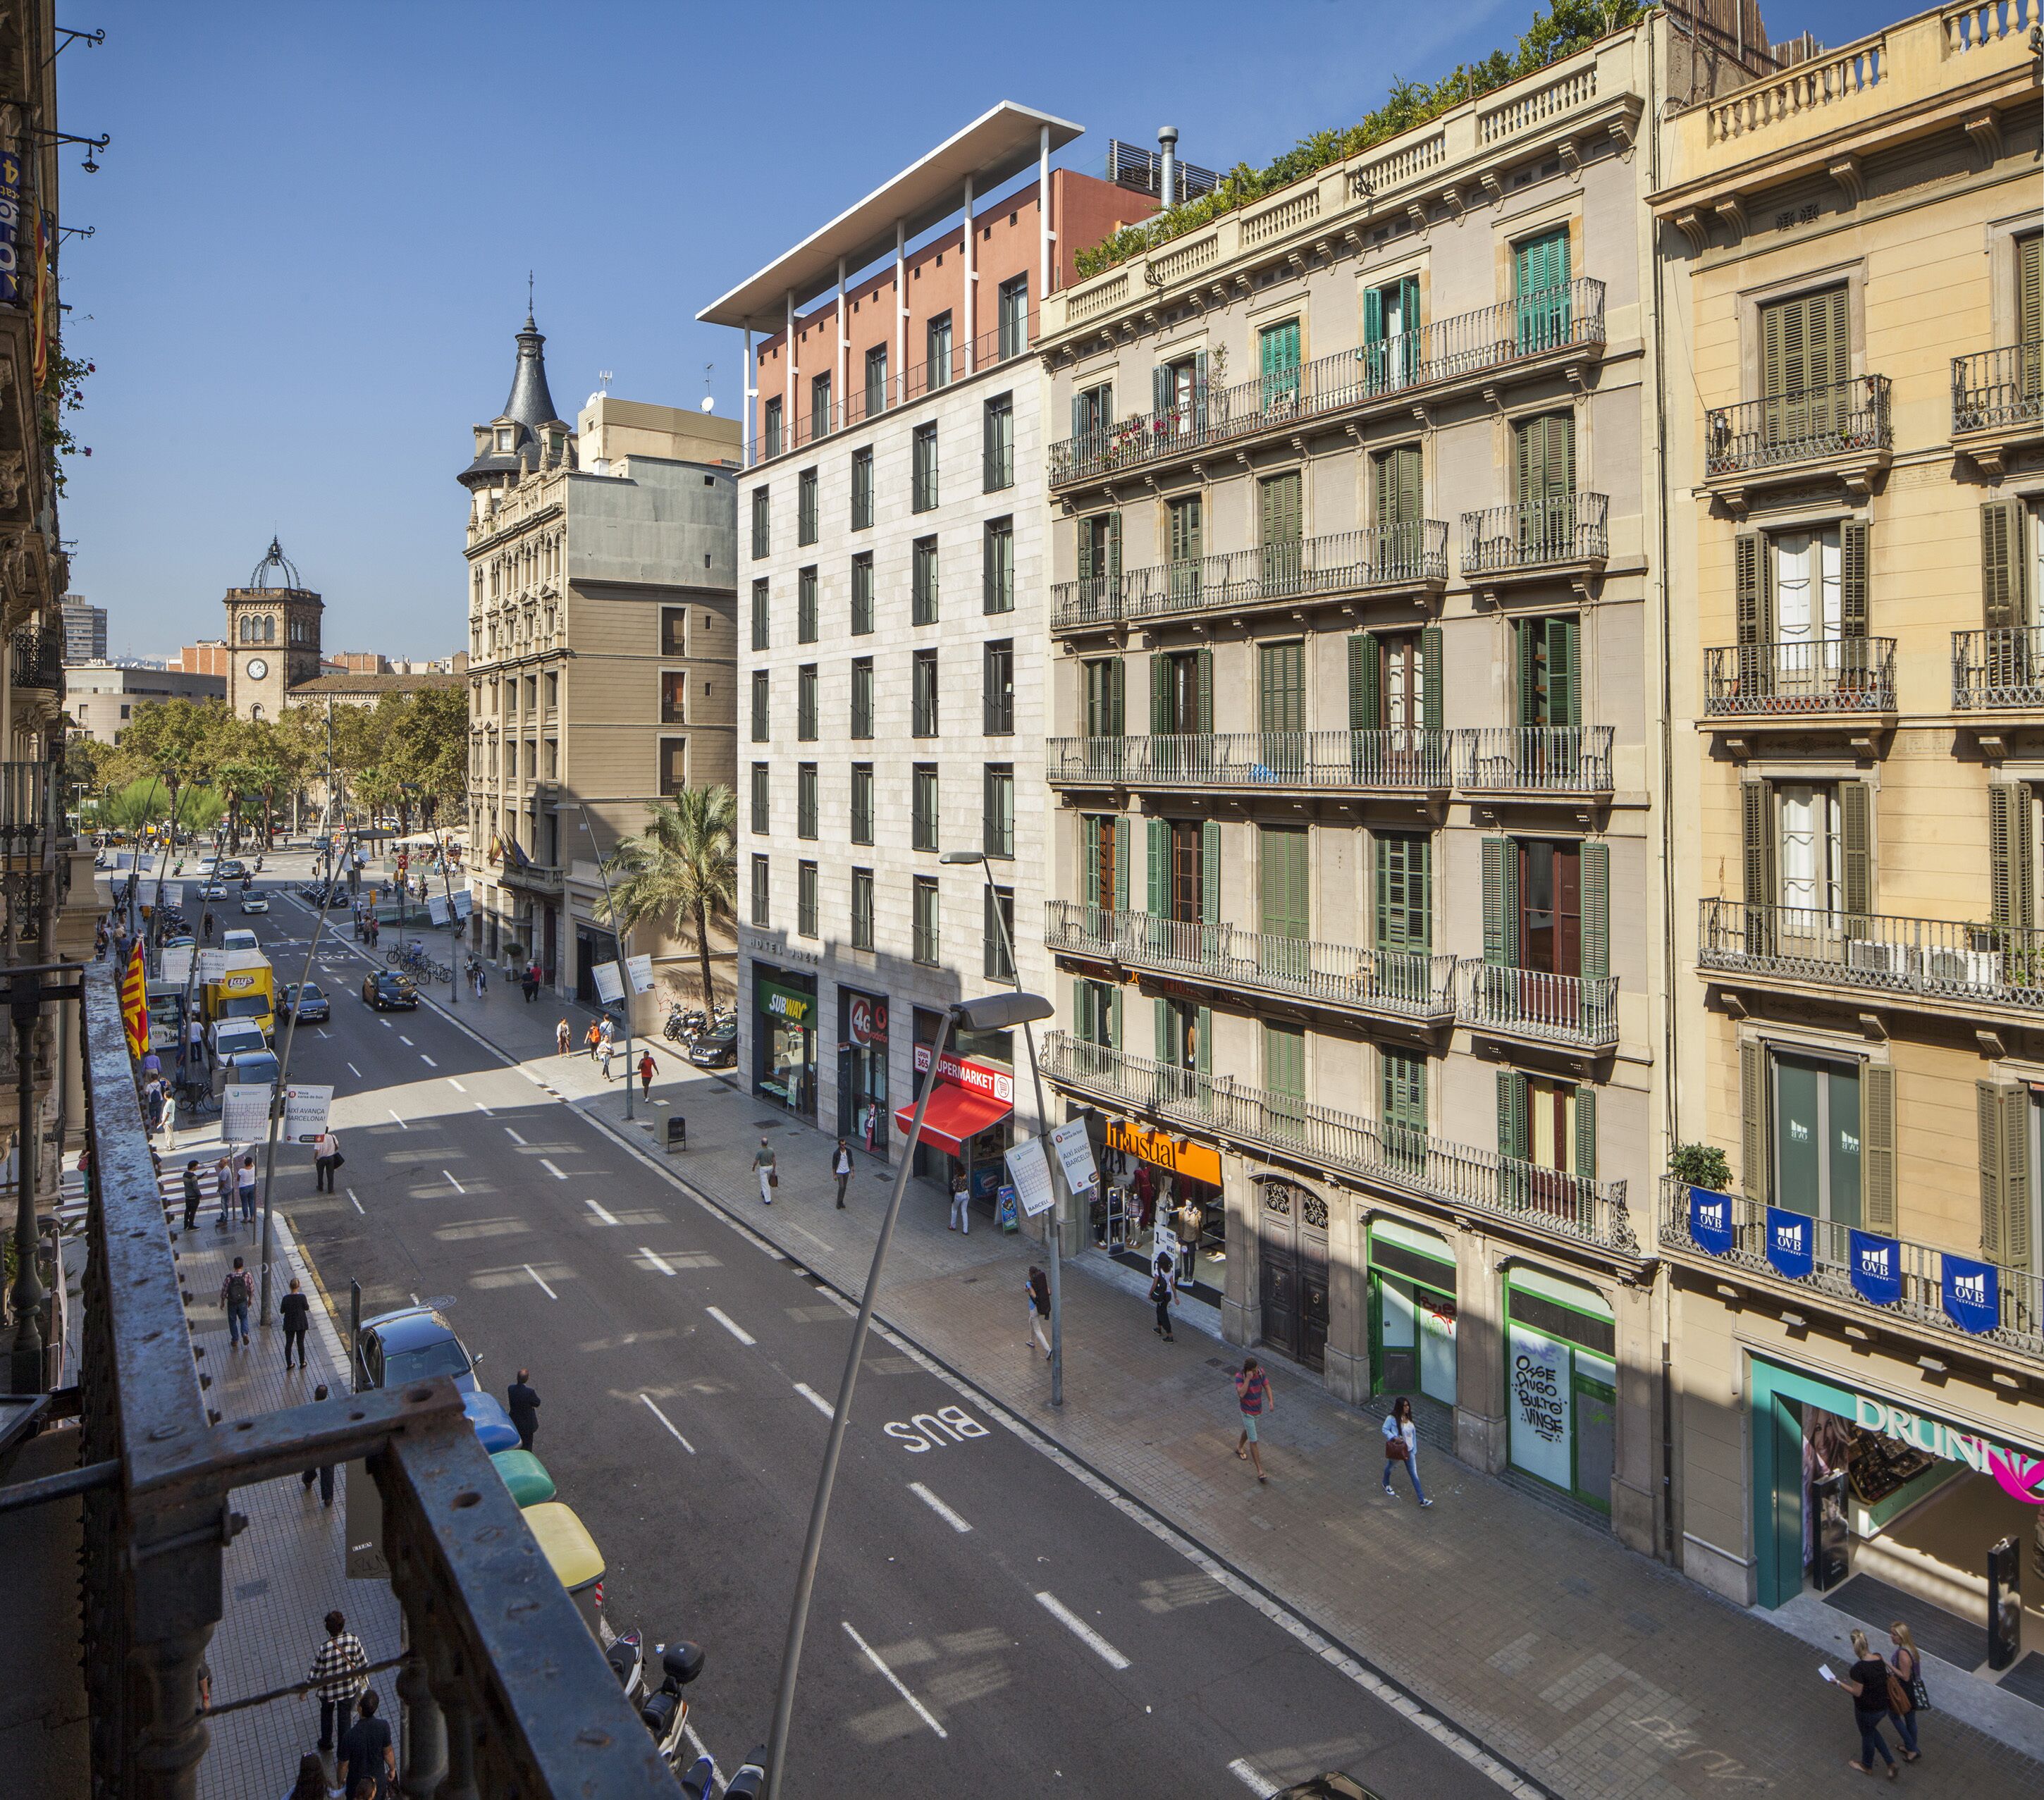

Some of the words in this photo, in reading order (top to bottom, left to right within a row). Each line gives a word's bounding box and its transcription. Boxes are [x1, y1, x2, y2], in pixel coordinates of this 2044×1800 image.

[751, 938, 783, 955] HOTEL
[792, 949, 818, 965] JAZZ
[769, 994, 808, 1020] SUBWAY
[854, 1006, 871, 1033] 4G
[918, 1051, 928, 1059] OPEN
[918, 1059, 928, 1068] 365
[937, 1059, 994, 1090] UPERMARKET
[1700, 1214, 1722, 1229] OVB
[1778, 1236, 1802, 1251] OVB
[1862, 1260, 1889, 1276] OVB
[1955, 1286, 1985, 1303] OVB
[883, 1405, 991, 1453] BUS
[1854, 1393, 1994, 1476] DRUNI
